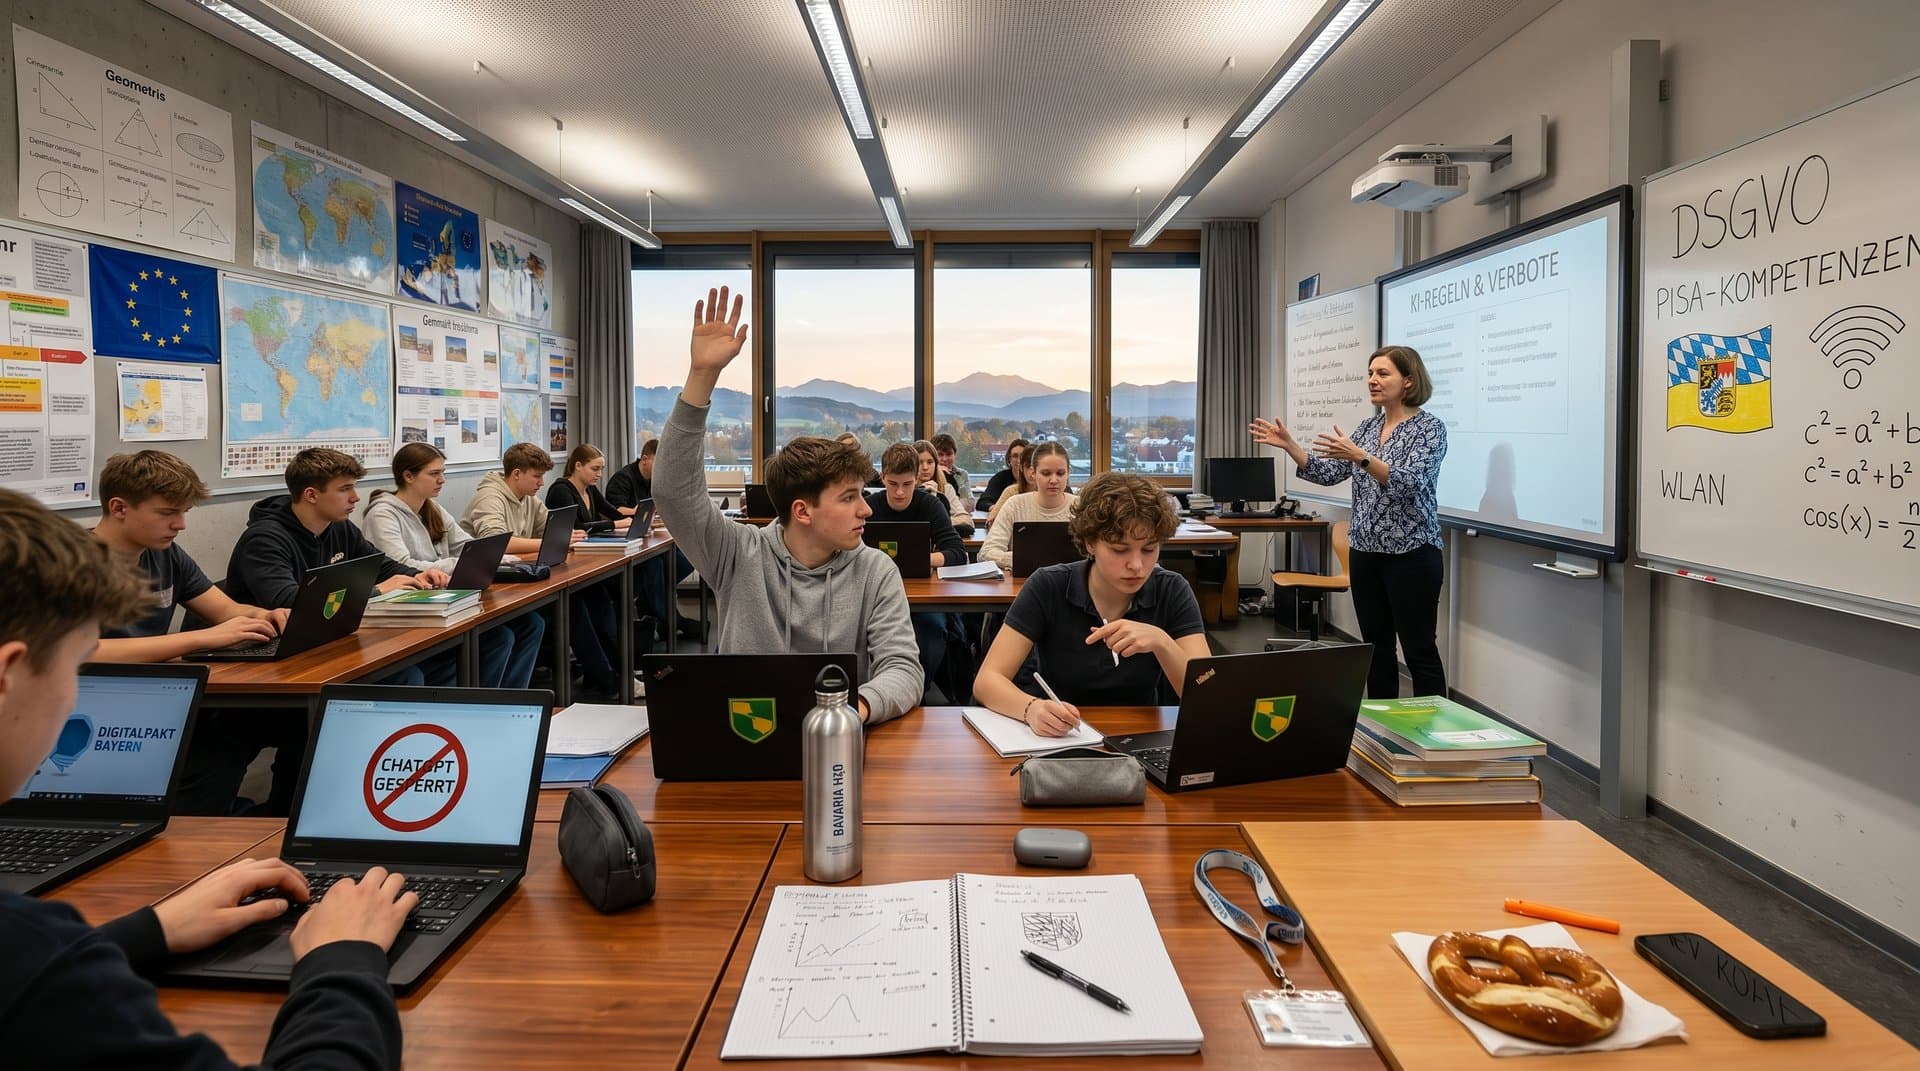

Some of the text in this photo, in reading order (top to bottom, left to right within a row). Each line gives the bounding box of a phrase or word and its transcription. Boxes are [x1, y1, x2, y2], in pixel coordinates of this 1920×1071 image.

[105, 69, 167, 102] Geometris
[1671, 154, 1830, 259] DSGVO
[1410, 251, 1560, 314] KI-REGELN & VERBOTE
[1657, 233, 1920, 320] PISA-KOMPETENZEN
[1661, 469, 1726, 506] WLAN
[94, 739, 143, 753] BAYERN
[98, 726, 177, 740] DIGITALPAKT
[374, 777, 456, 793] GESERRT
[833, 788, 844, 837] BAVARIA
